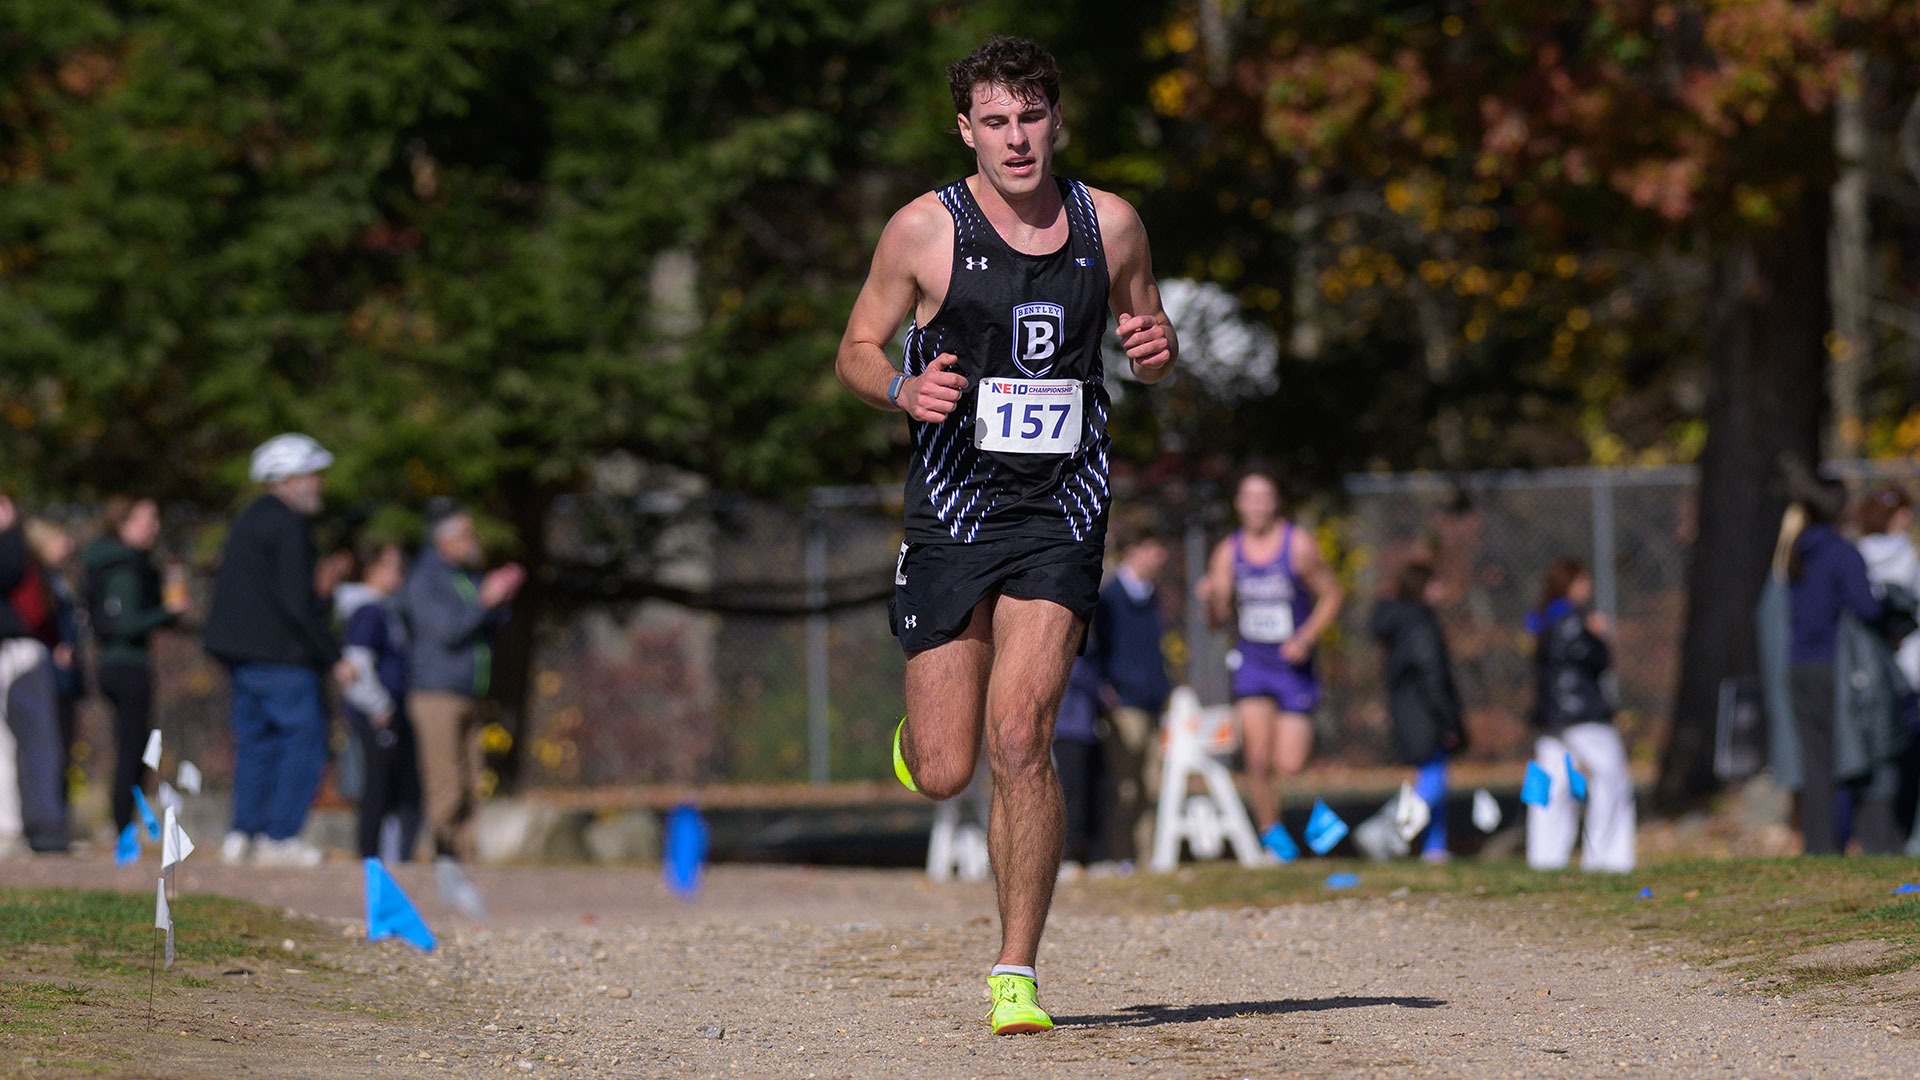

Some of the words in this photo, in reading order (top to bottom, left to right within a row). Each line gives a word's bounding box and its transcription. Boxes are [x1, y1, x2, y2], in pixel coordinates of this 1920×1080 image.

[1017, 306, 1060, 317] BENTLEY
[1023, 321, 1055, 360] B
[991, 382, 1028, 395] NE10
[1028, 386, 1073, 394] CHAMPIONSHIP
[996, 402, 1071, 440] 157
